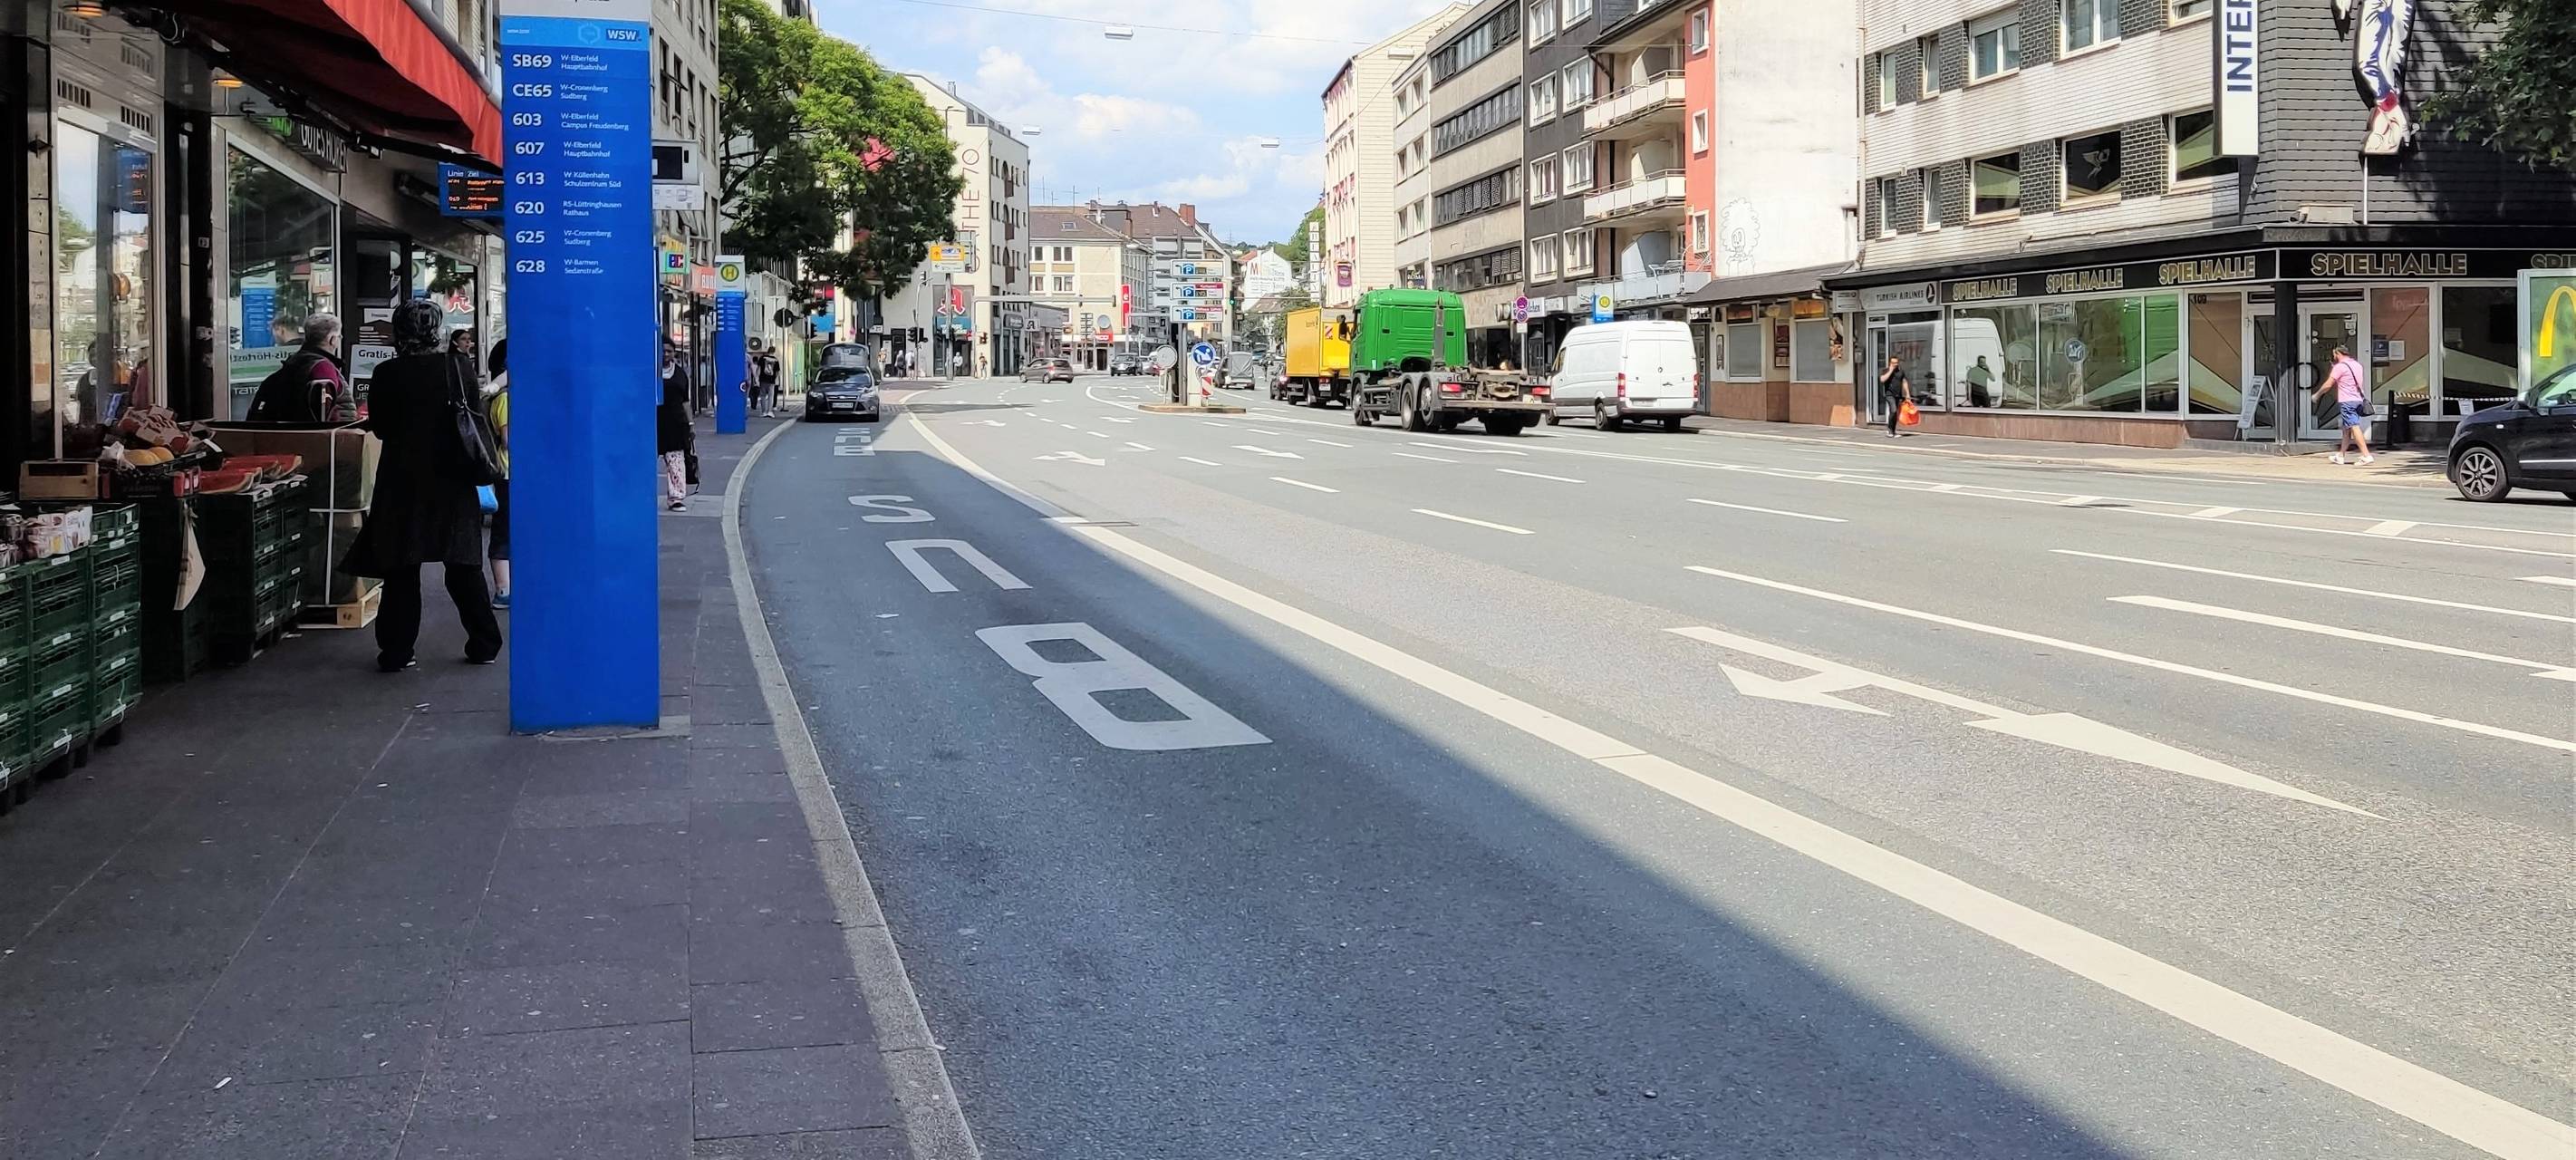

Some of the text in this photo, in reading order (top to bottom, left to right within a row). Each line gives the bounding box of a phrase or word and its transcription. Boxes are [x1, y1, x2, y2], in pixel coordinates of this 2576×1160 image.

[607, 30, 636, 40] WSW
[512, 53, 552, 68] SB69
[560, 54, 599, 63] W-Elberfeld
[561, 63, 608, 72] Hauptbahnhof
[512, 83, 553, 98] CE65
[560, 83, 609, 93] W-Cronenberg
[560, 92, 588, 102] Sudberg
[512, 112, 542, 126] 603
[561, 112, 599, 121] W-Elberfeld
[561, 121, 630, 131] Campus Freudenberg
[515, 141, 545, 155] 607
[564, 150, 611, 158] Hauptbahnhof
[515, 171, 545, 185] 613
[608, 179, 622, 188] Süd
[515, 201, 545, 215] 620
[516, 230, 545, 244] 625
[564, 229, 612, 238] W-Cronenberg
[564, 238, 591, 246] Sudberg
[516, 259, 545, 273] 628
[2158, 256, 2256, 285] SPIELHALLE
[2311, 252, 2467, 276] SPIELHALLE
[2045, 267, 2123, 294] SPIELHALLE
[1953, 277, 2018, 301] SPIELHALLE
